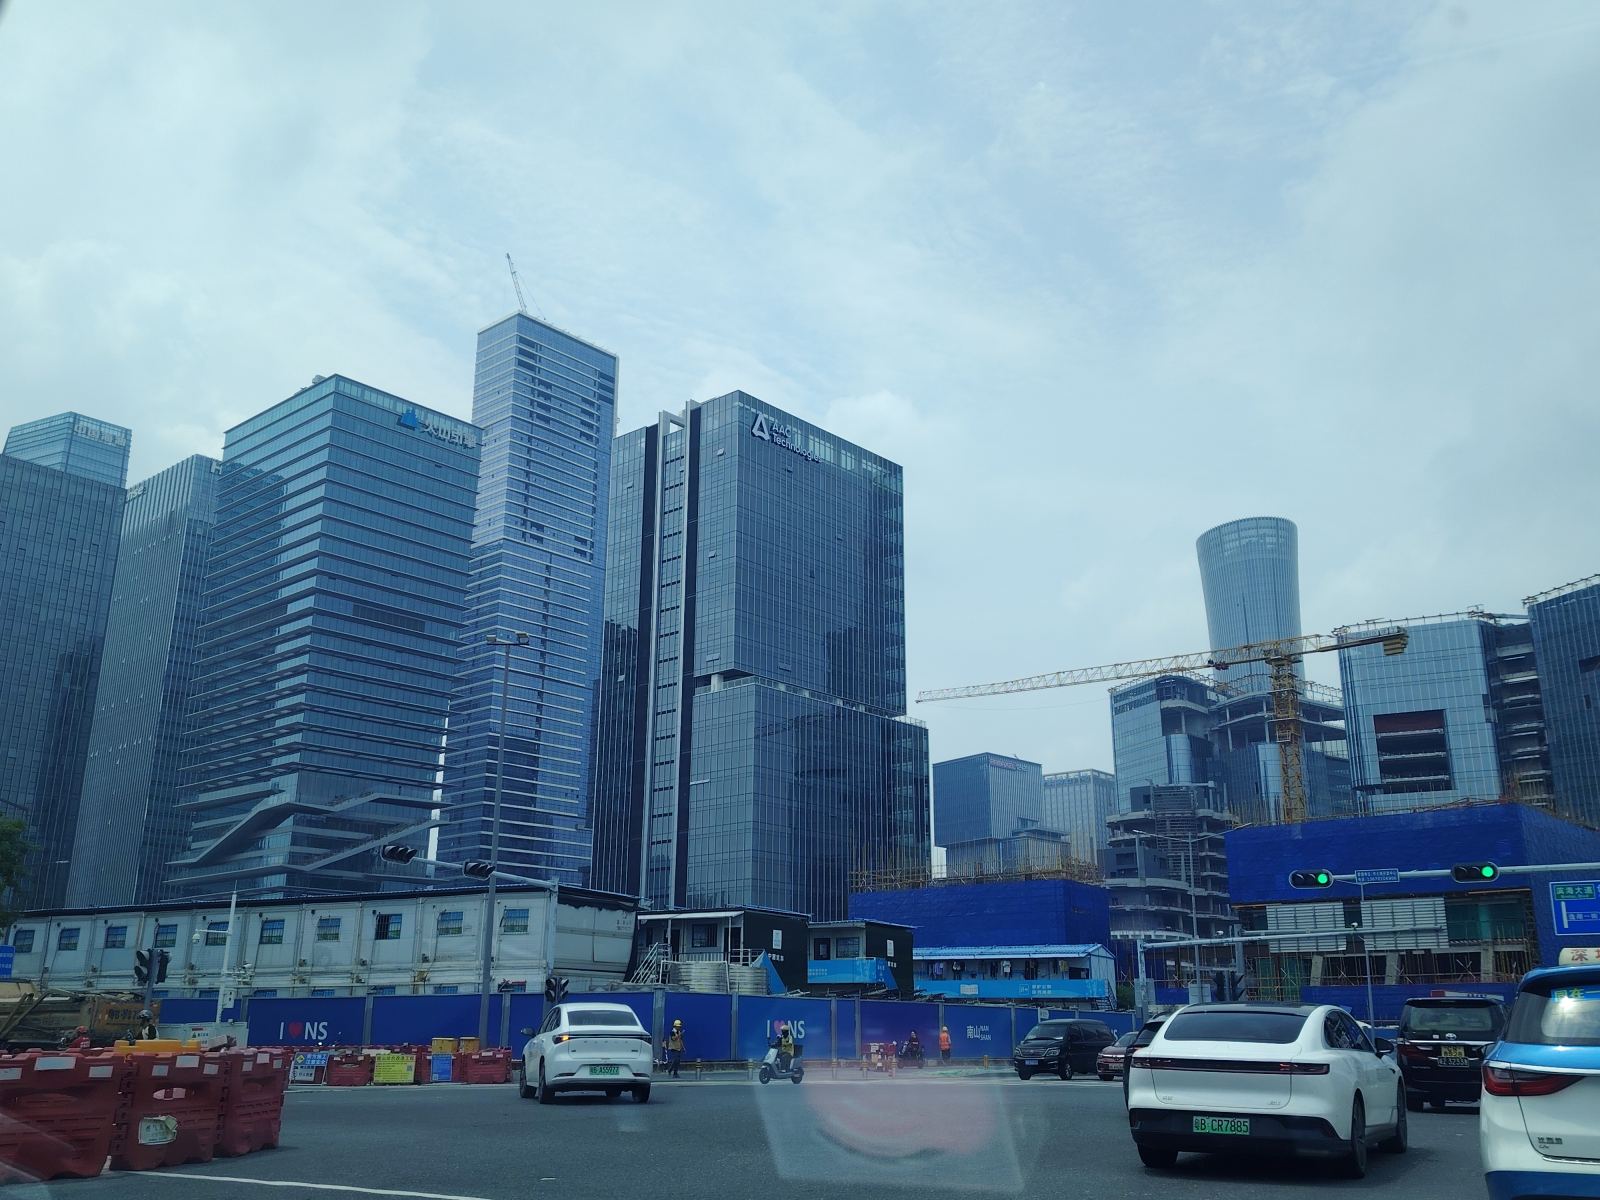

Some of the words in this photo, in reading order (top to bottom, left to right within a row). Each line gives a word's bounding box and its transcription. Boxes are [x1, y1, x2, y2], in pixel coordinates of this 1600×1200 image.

[772, 420, 792, 438] AAC
[772, 432, 822, 463] Technologies
[279, 1022, 285, 1040] I
[304, 1022, 328, 1040] NS
[788, 1020, 806, 1038] NS
[966, 1025, 980, 1039] 南山
